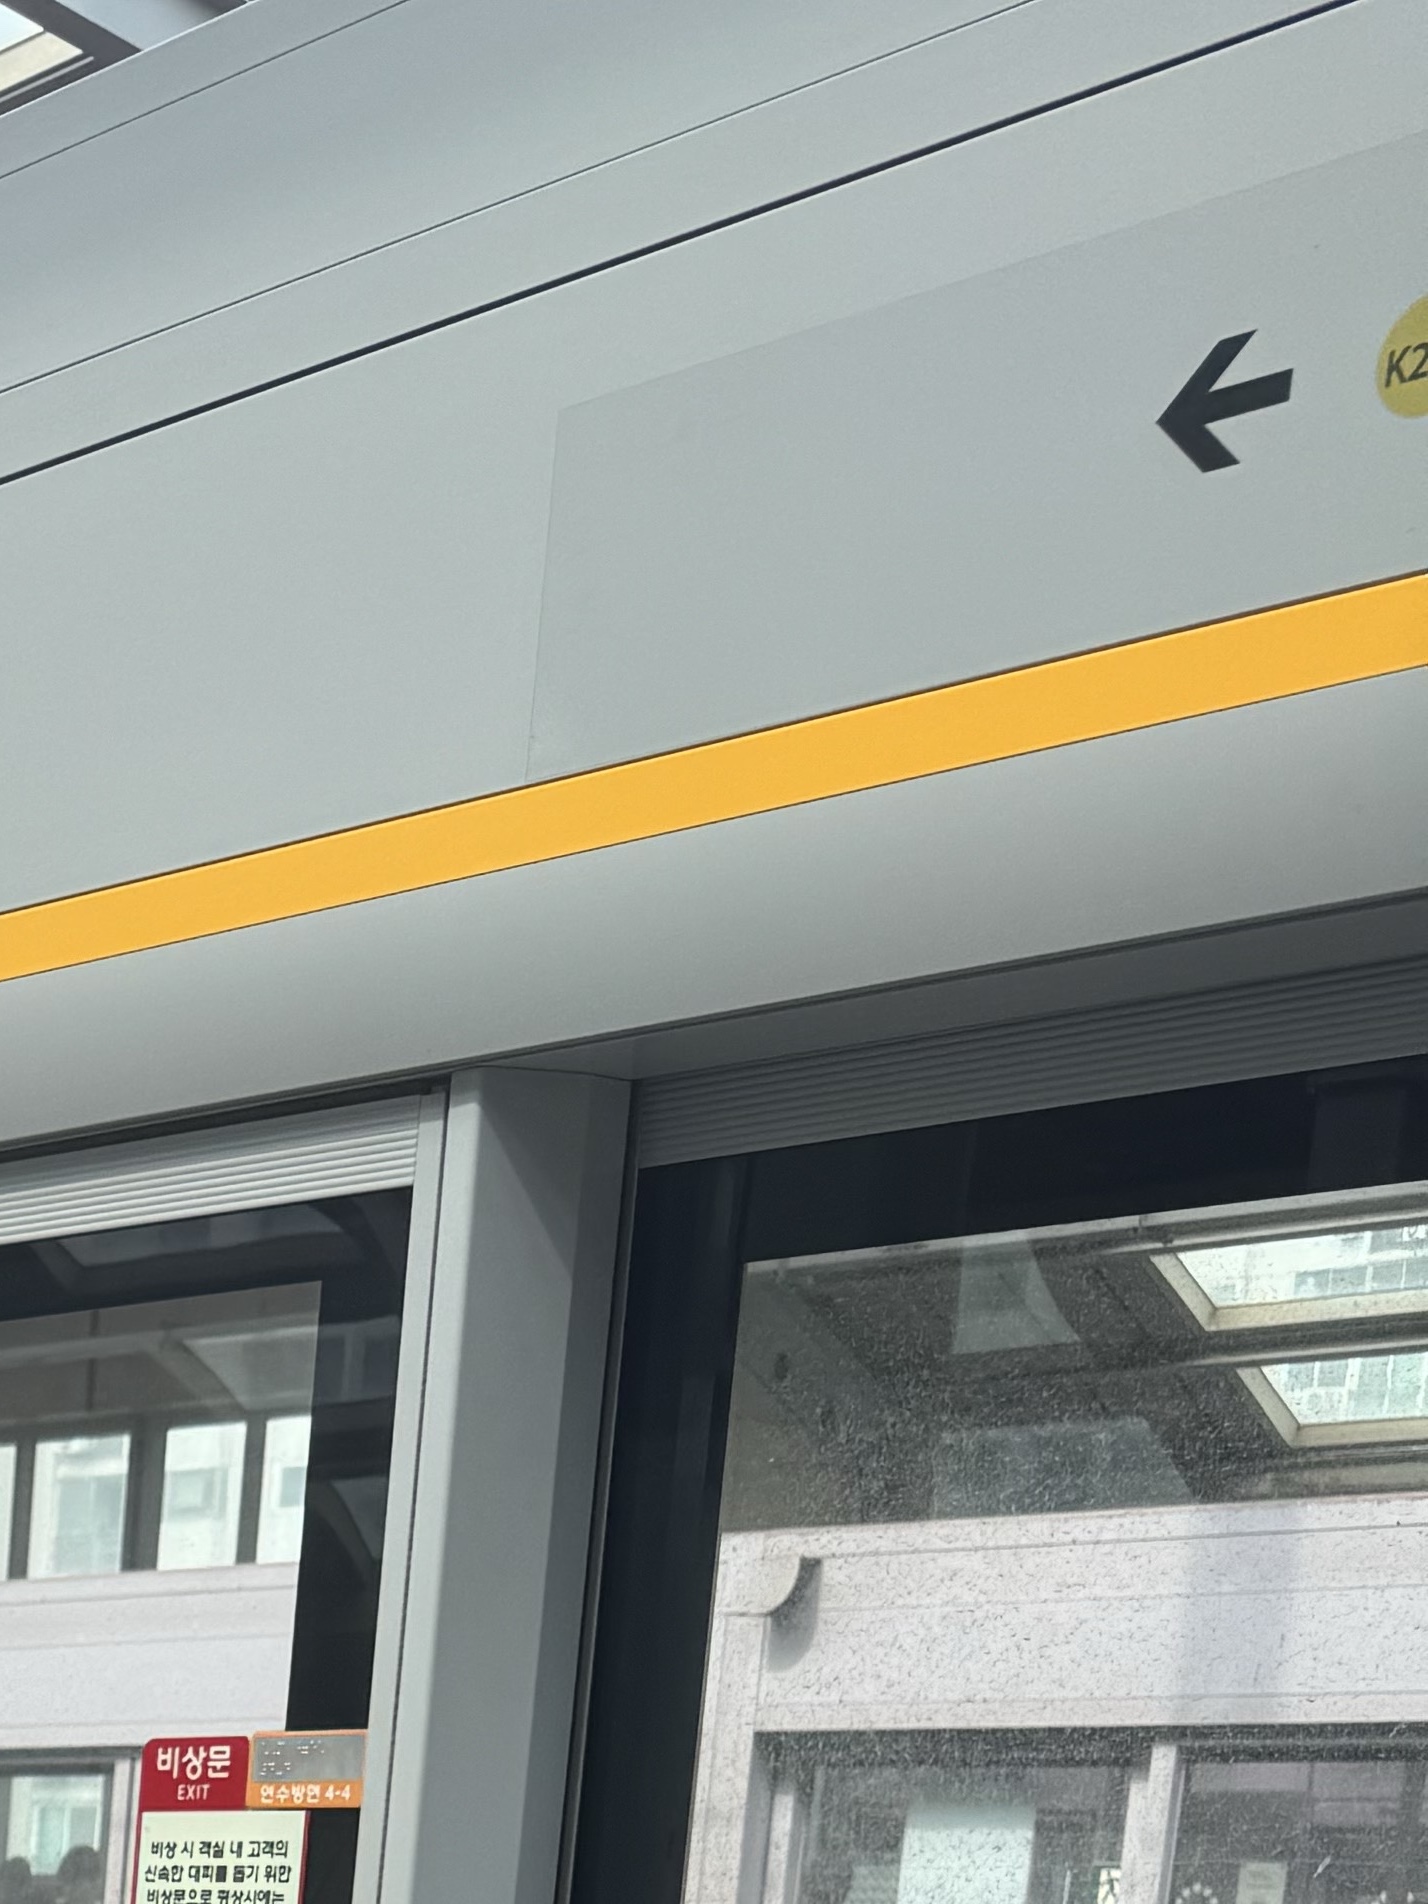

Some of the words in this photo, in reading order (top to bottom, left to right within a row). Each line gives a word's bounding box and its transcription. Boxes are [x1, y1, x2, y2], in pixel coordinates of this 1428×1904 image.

[156, 1745, 232, 1780] 비상문
[177, 1783, 211, 1801] EXIT
[260, 1783, 320, 1804] 연수방면
[325, 1783, 351, 1801] 4-4
[150, 1841, 177, 1859] 비상
[181, 1841, 194, 1859] 시
[198, 1841, 225, 1859] 객실
[230, 1841, 243, 1859] 내
[247, 1840, 289, 1859] 고객의
[144, 1865, 184, 1884] 신속한
[188, 1865, 227, 1884] 대피를
[233, 1865, 259, 1883] 돕기
[264, 1865, 291, 1883] 위한
